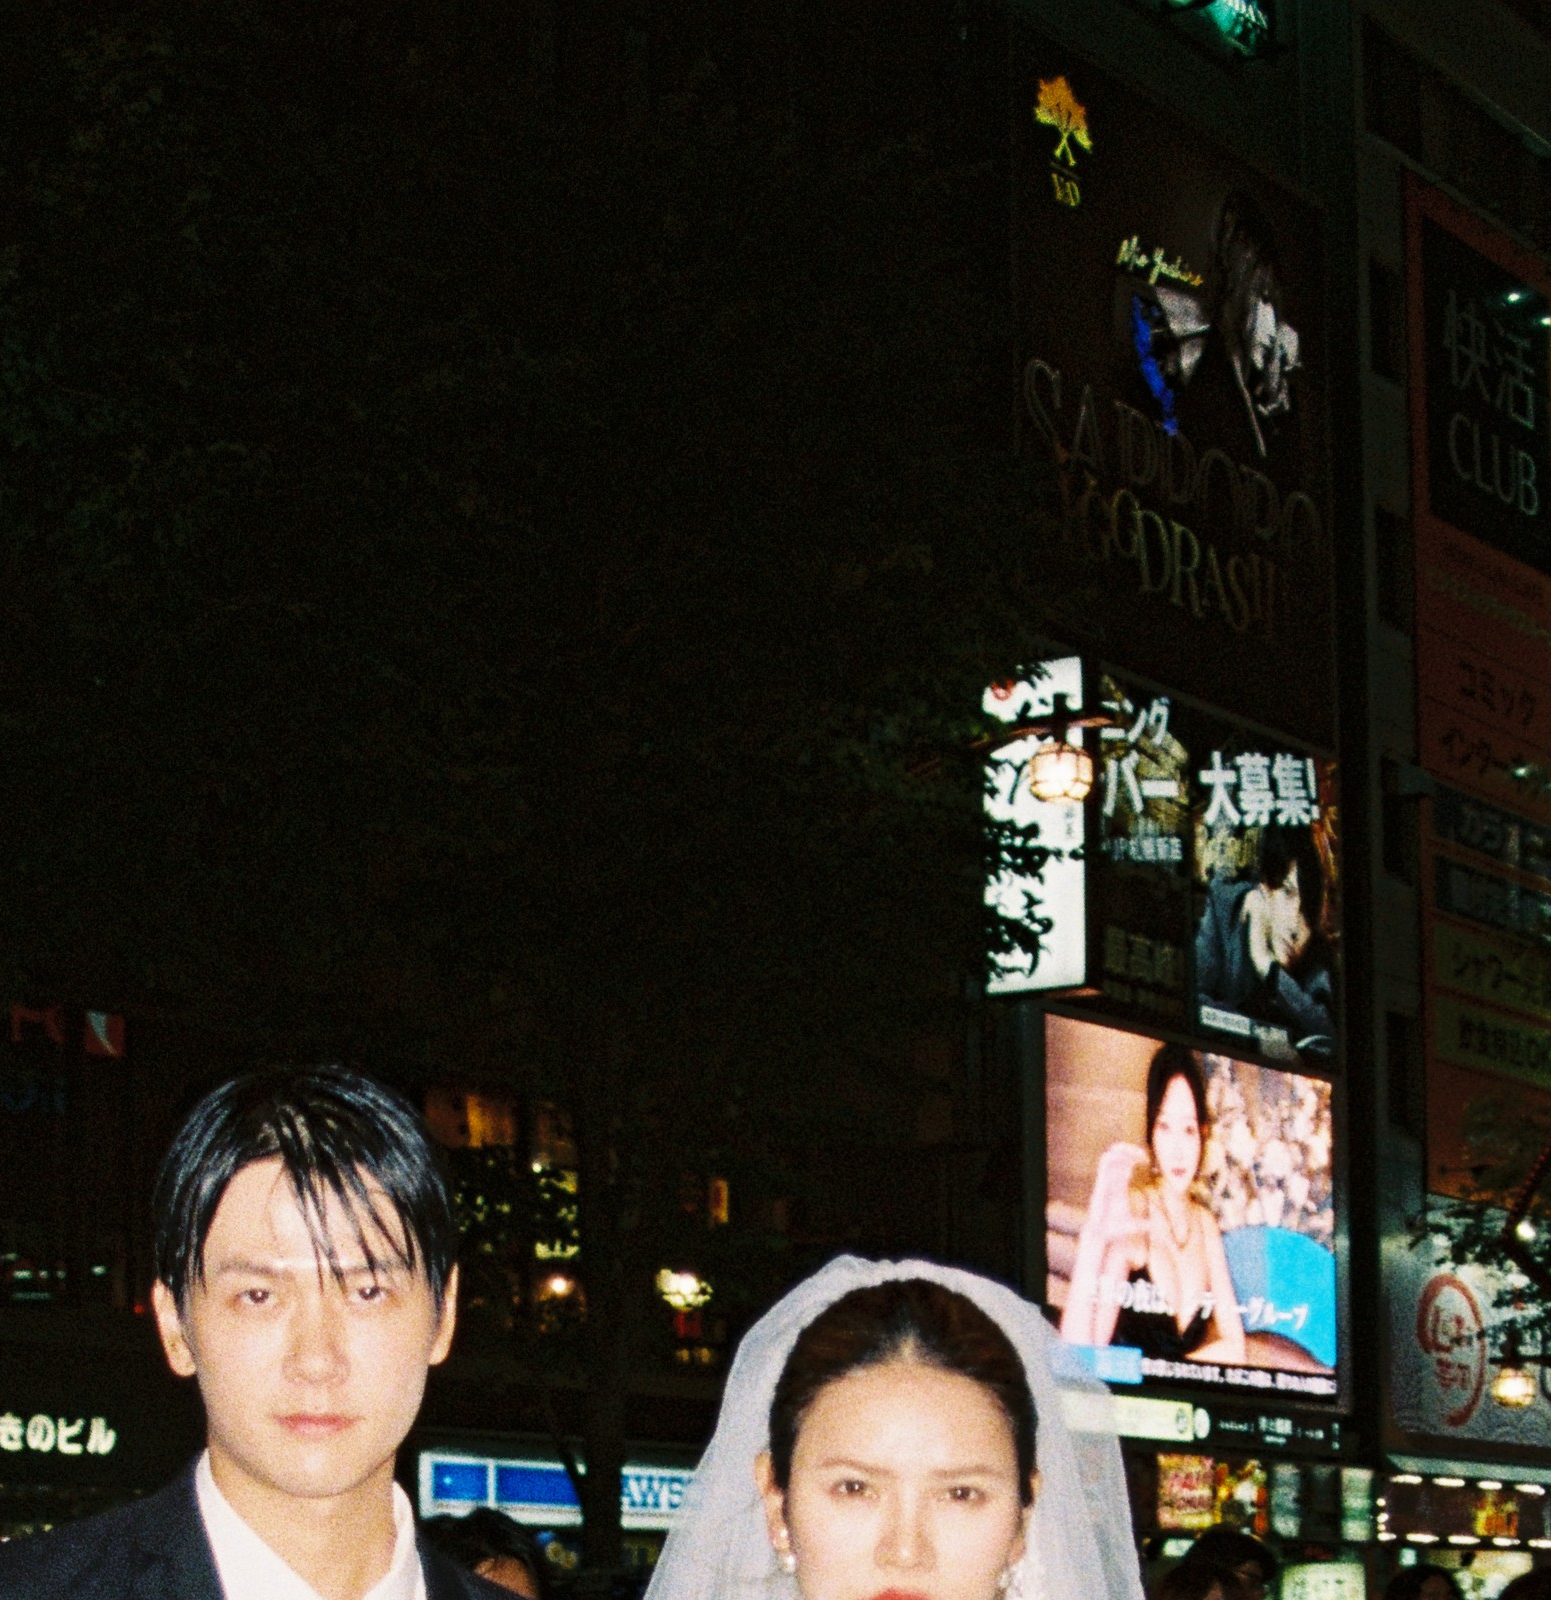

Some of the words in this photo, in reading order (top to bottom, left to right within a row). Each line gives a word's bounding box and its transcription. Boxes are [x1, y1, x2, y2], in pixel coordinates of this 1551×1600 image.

[1449, 411, 1540, 518] CLUB
[1100, 696, 1171, 747] ニング
[1101, 749, 1179, 818] バー
[1199, 751, 1320, 826] 大募集!
[621, 1475, 687, 1512] AWS
